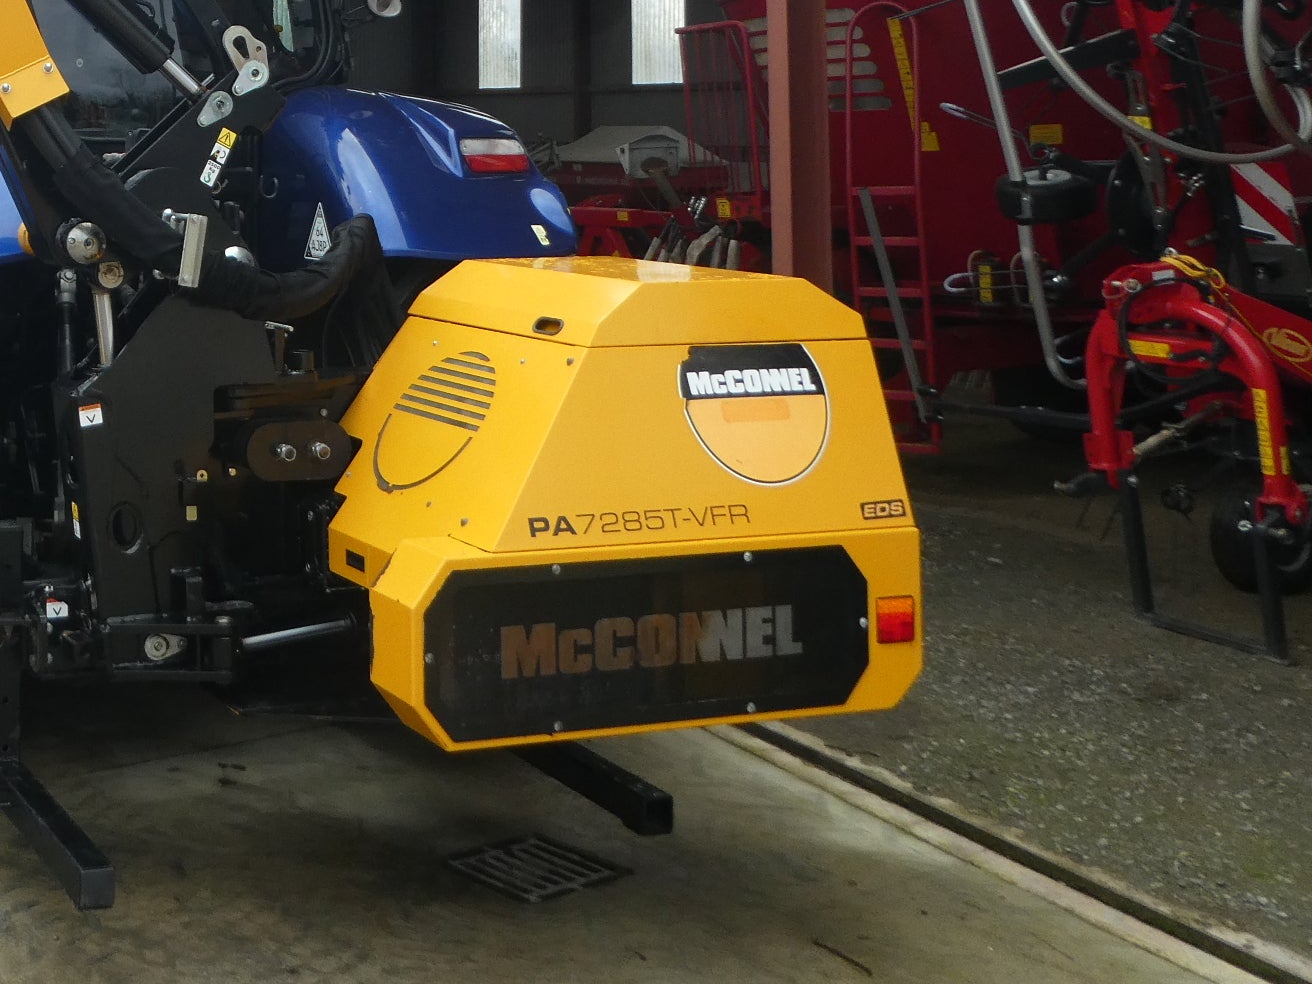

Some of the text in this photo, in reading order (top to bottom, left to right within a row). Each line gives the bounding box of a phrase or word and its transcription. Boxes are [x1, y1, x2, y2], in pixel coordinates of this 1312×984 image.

[686, 367, 817, 396] McCONNEL
[527, 504, 751, 538] PA7285T-VFR
[863, 500, 905, 518] EDS
[499, 604, 803, 680] McCONNEL
